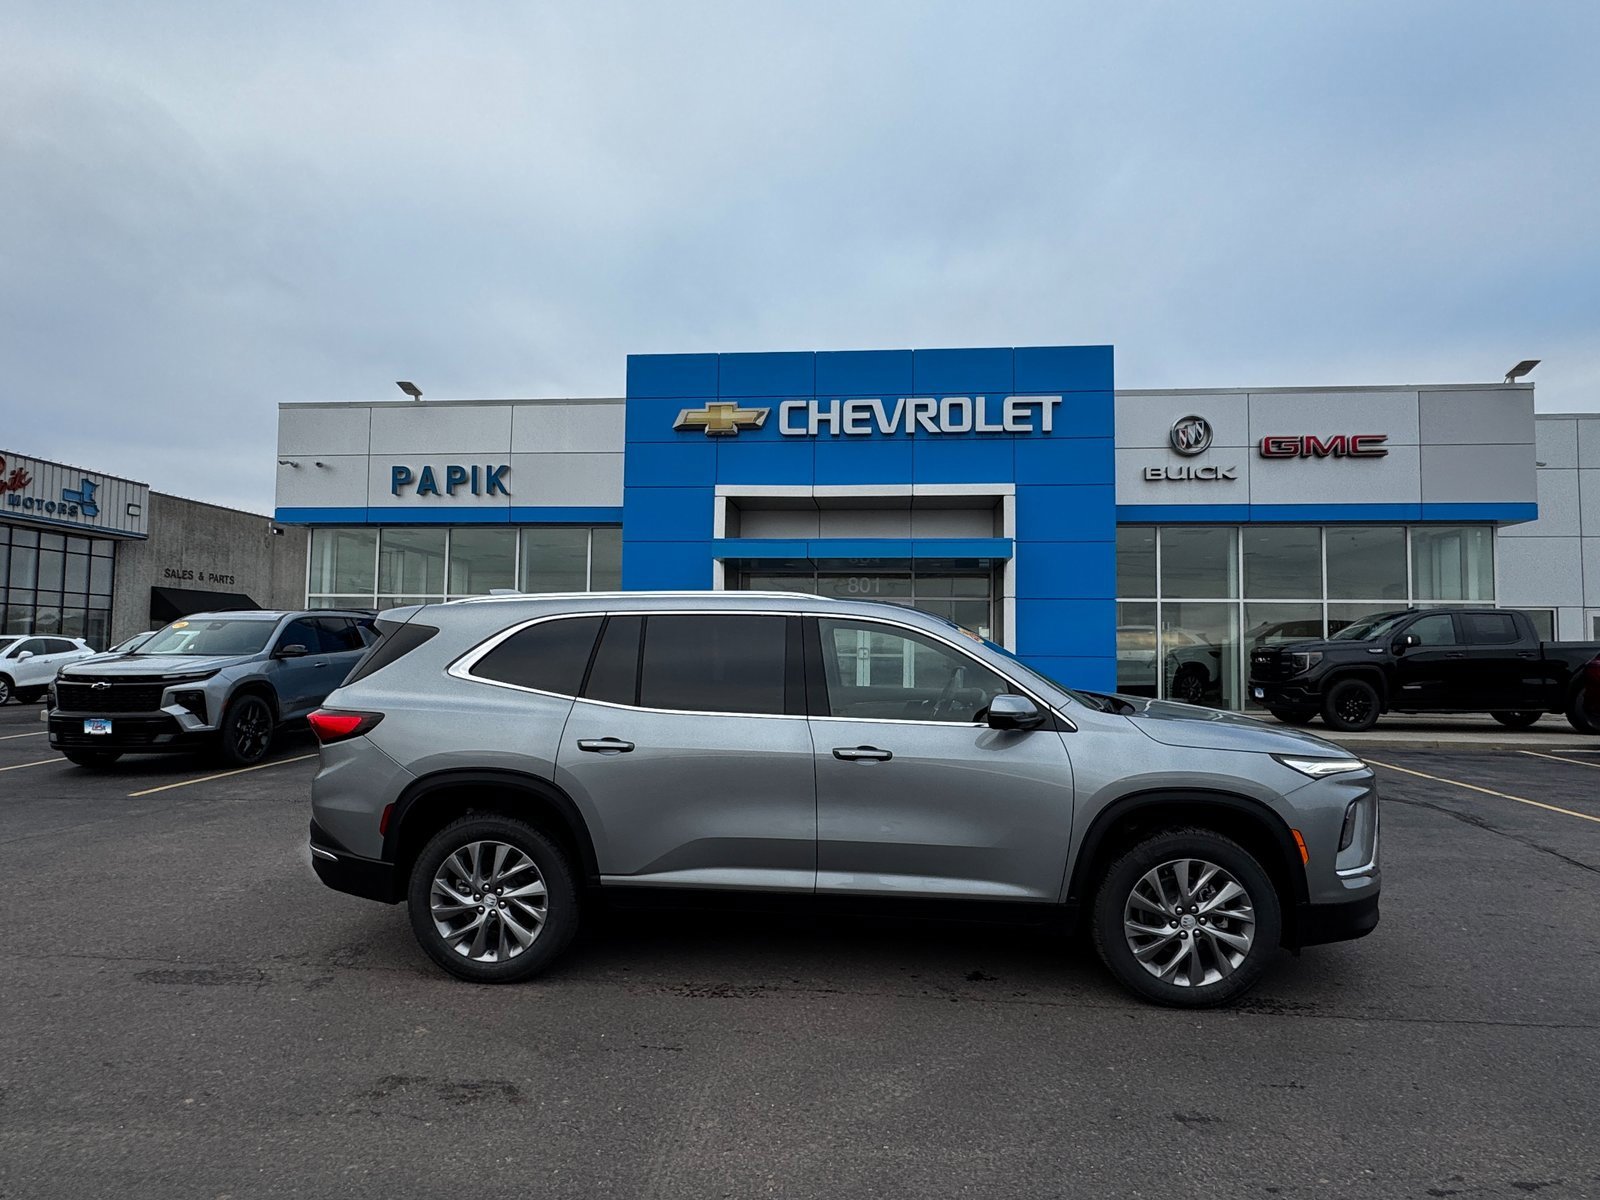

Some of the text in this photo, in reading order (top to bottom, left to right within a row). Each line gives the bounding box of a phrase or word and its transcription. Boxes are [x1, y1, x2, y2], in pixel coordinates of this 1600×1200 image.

[778, 395, 1063, 436] CHEVROLET
[1260, 434, 1389, 458] GMC
[391, 465, 511, 496] PAPIK
[1144, 466, 1238, 481] BUICK
[8, 493, 79, 517] MOTORS
[164, 568, 235, 585] SALES & PARTS
[848, 577, 880, 593] 801
